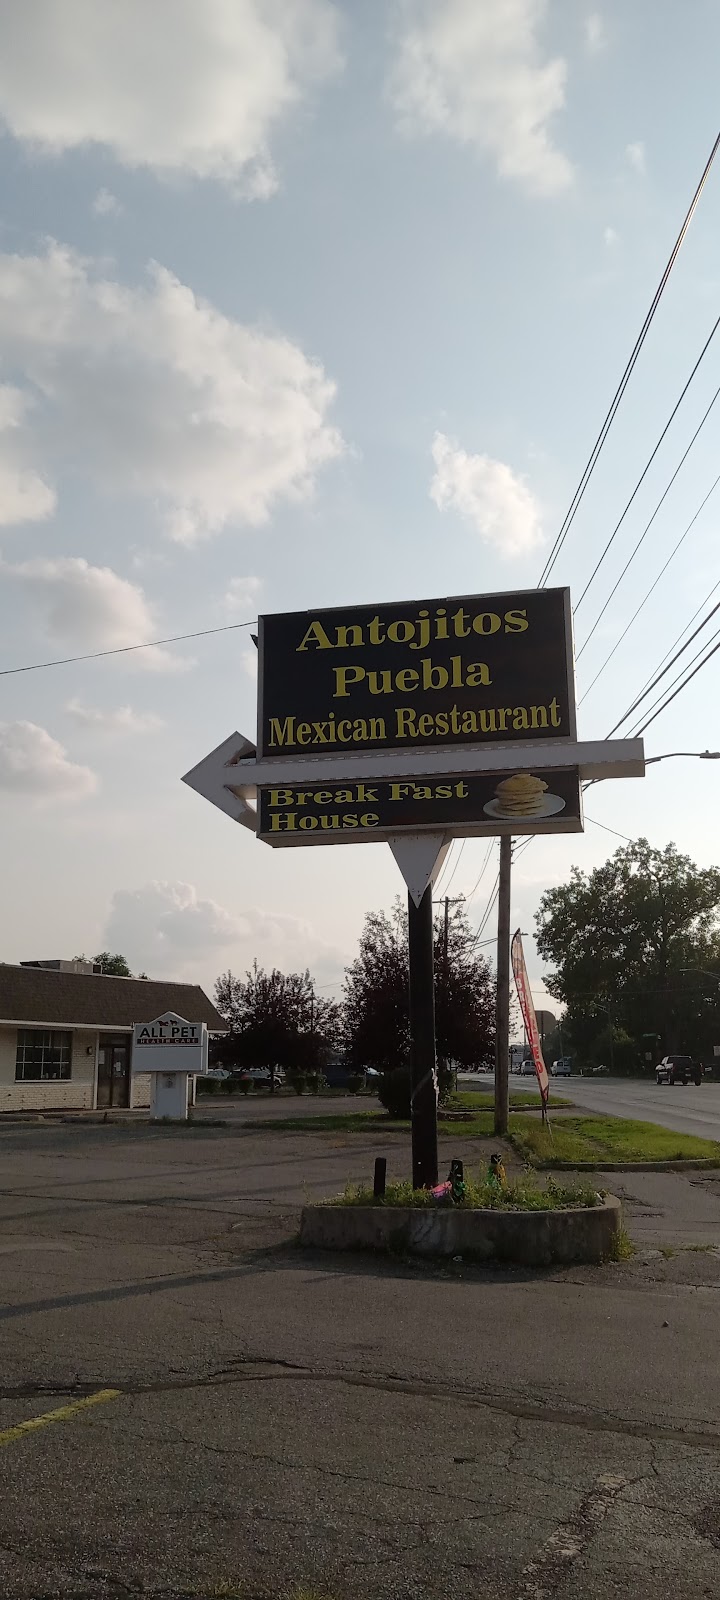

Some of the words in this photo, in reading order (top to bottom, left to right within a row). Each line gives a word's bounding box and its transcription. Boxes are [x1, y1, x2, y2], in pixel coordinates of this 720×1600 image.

[295, 607, 530, 652] Antojitos
[332, 655, 493, 698] Puebla
[268, 711, 387, 747] Mexican
[394, 696, 562, 739] Restaurant
[267, 784, 379, 807] Break
[388, 780, 469, 802] Fast
[268, 811, 380, 832] House
[140, 1028, 166, 1038] ALL
[171, 1026, 197, 1037] PET
